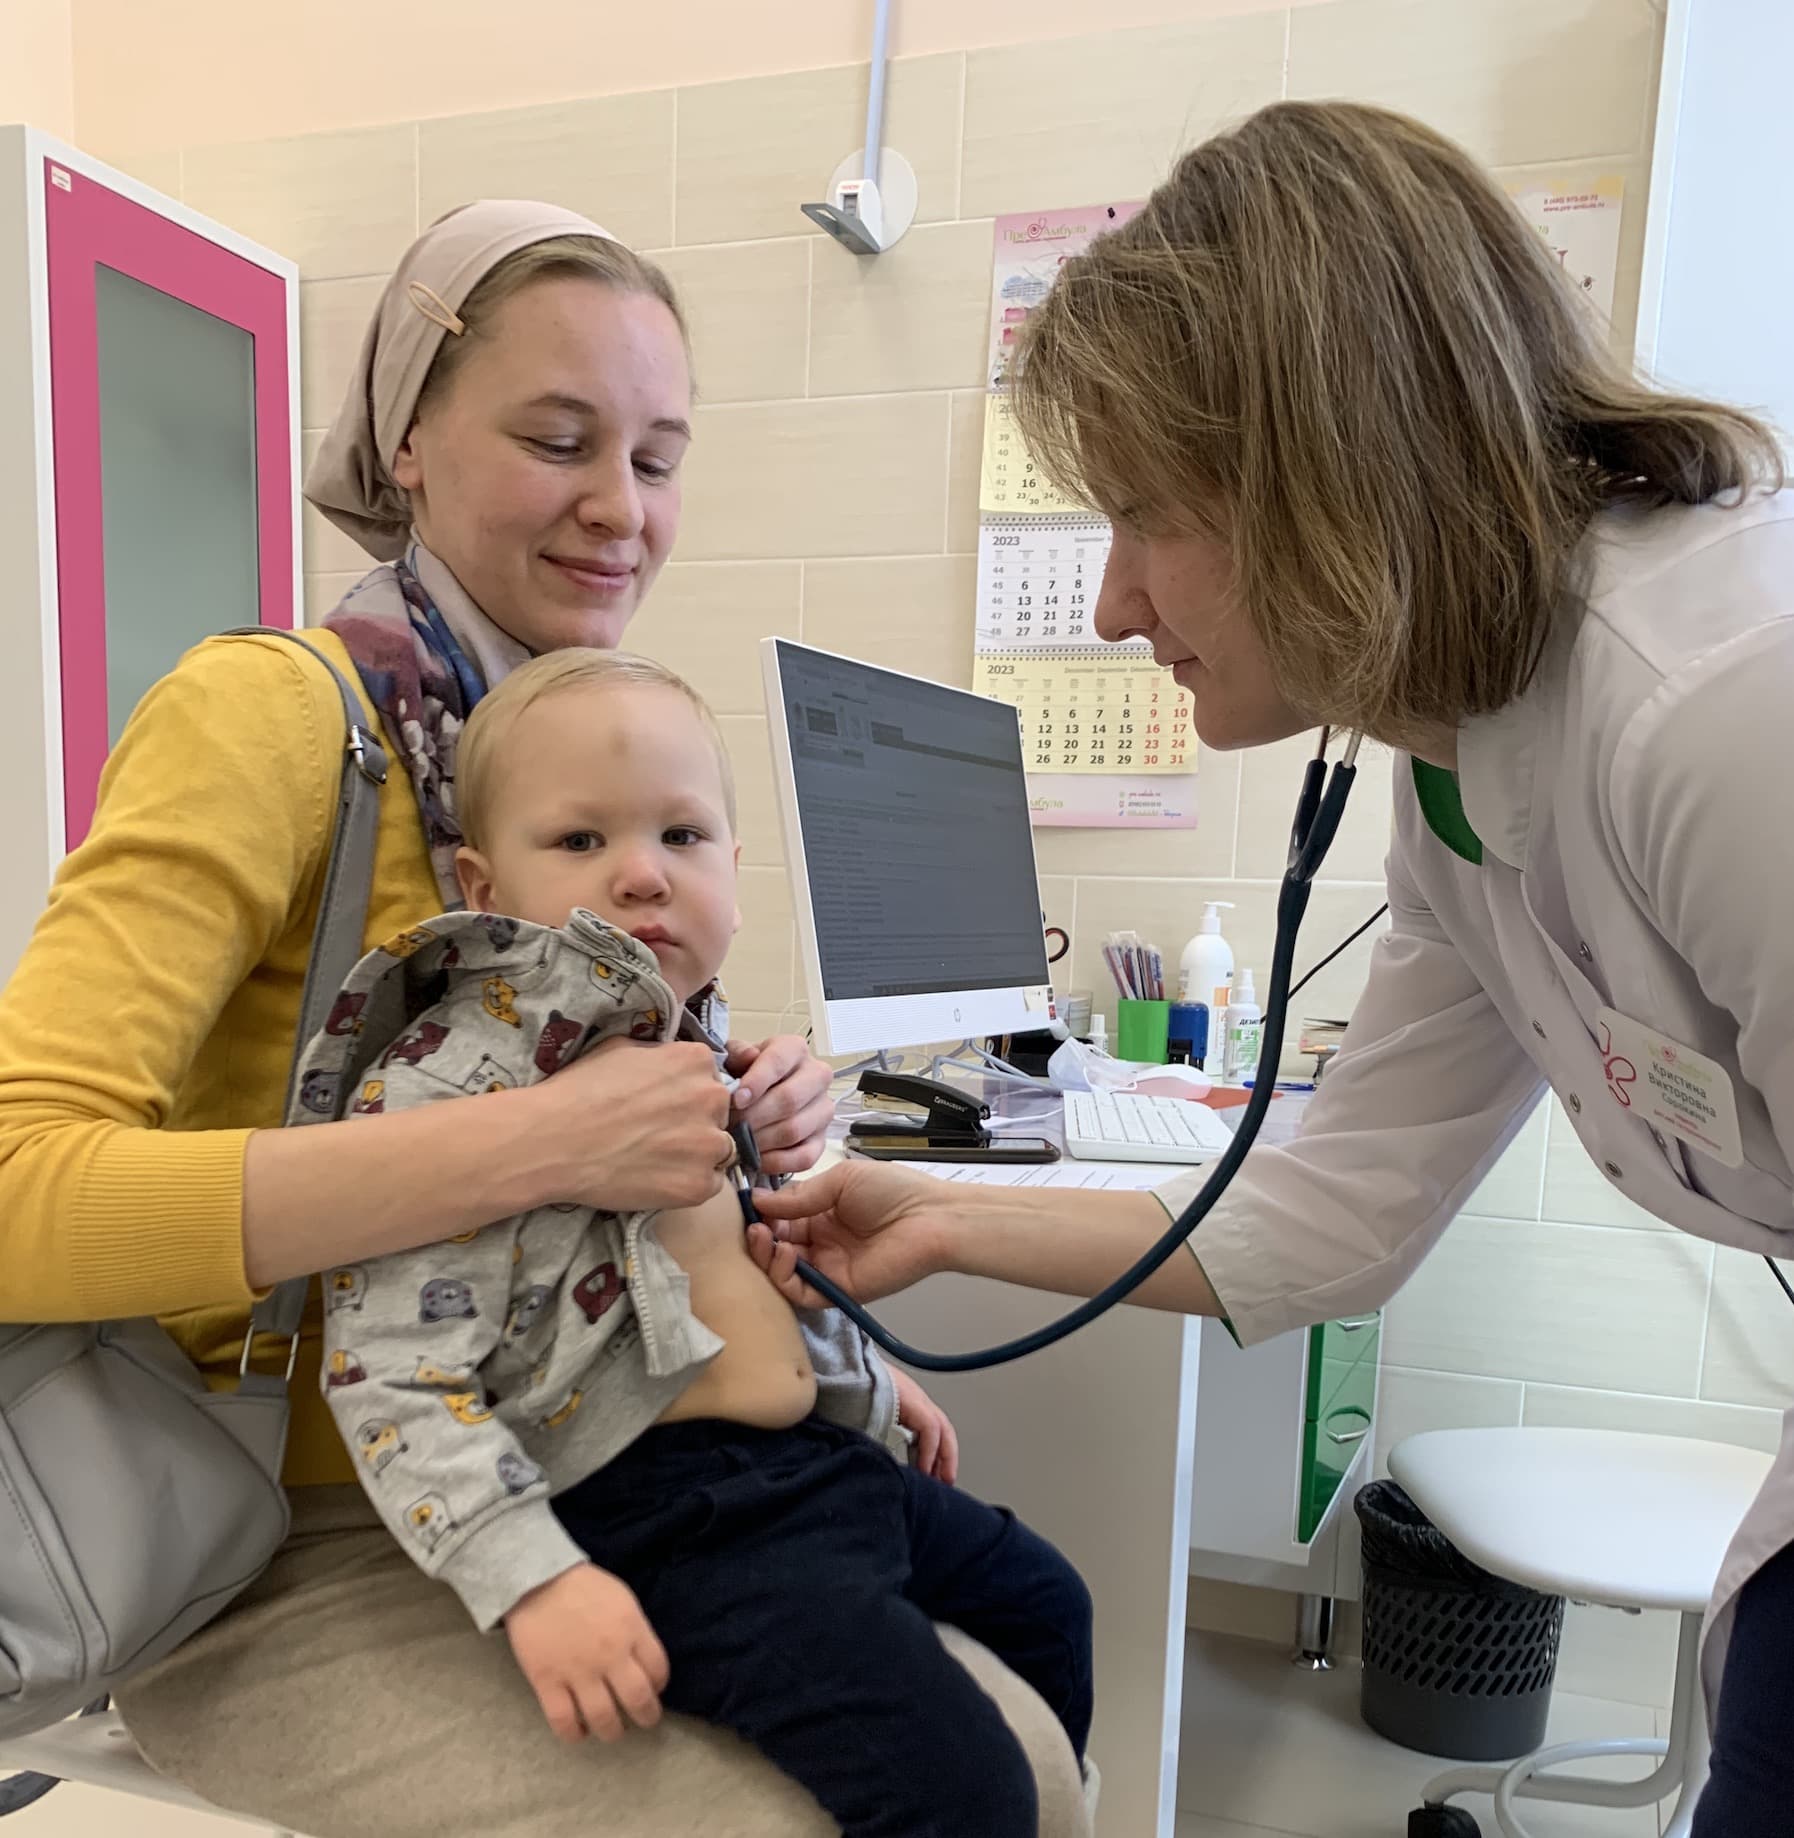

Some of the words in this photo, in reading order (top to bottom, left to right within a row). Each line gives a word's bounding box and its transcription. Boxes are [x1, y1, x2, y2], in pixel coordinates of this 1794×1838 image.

[1026, 463, 1033, 472] 9
[1022, 479, 1036, 488] 16
[992, 536, 1020, 546] 2023
[1076, 564, 1083, 573] 1
[1021, 580, 1029, 590] 6
[1048, 580, 1056, 589] 7
[1074, 579, 1082, 588] 8
[1017, 596, 1032, 606] 13
[1044, 595, 1058, 605] 14
[1070, 594, 1085, 604] 15
[1016, 611, 1031, 621] 20
[1043, 611, 1056, 620] 21
[1069, 609, 1084, 619] 22
[1016, 627, 1030, 636] 27
[1042, 626, 1056, 636] 28
[1068, 625, 1083, 635] 29
[987, 664, 1015, 674] 2023
[1124, 693, 1130, 703] 1
[1151, 693, 1158, 703] 2
[1177, 692, 1185, 702] 3
[1042, 709, 1050, 719] 5
[1069, 709, 1076, 719] 6
[1096, 709, 1104, 719] 7
[1122, 709, 1130, 718] 8
[1150, 708, 1157, 718] 9
[1173, 708, 1188, 718] 10
[1037, 724, 1052, 734] 12
[1064, 724, 1079, 734] 13
[1092, 724, 1106, 734] 14
[1119, 724, 1133, 734] 15
[1145, 724, 1160, 734] 16
[1172, 723, 1187, 733] 17
[1037, 739, 1051, 749] 19
[1064, 739, 1079, 749] 20
[1091, 739, 1104, 749] 21
[1117, 739, 1133, 749] 22
[1145, 739, 1159, 749] 23
[1171, 739, 1185, 748] 24
[1036, 754, 1051, 764] 26
[1063, 754, 1078, 764] 27
[1090, 754, 1105, 764] 28
[1117, 754, 1132, 764] 29
[1143, 755, 1158, 765] 30
[1169, 754, 1184, 764] 31
[1652, 1061, 1707, 1098] Кристина
[1648, 1072, 1717, 1118] Викторовна
